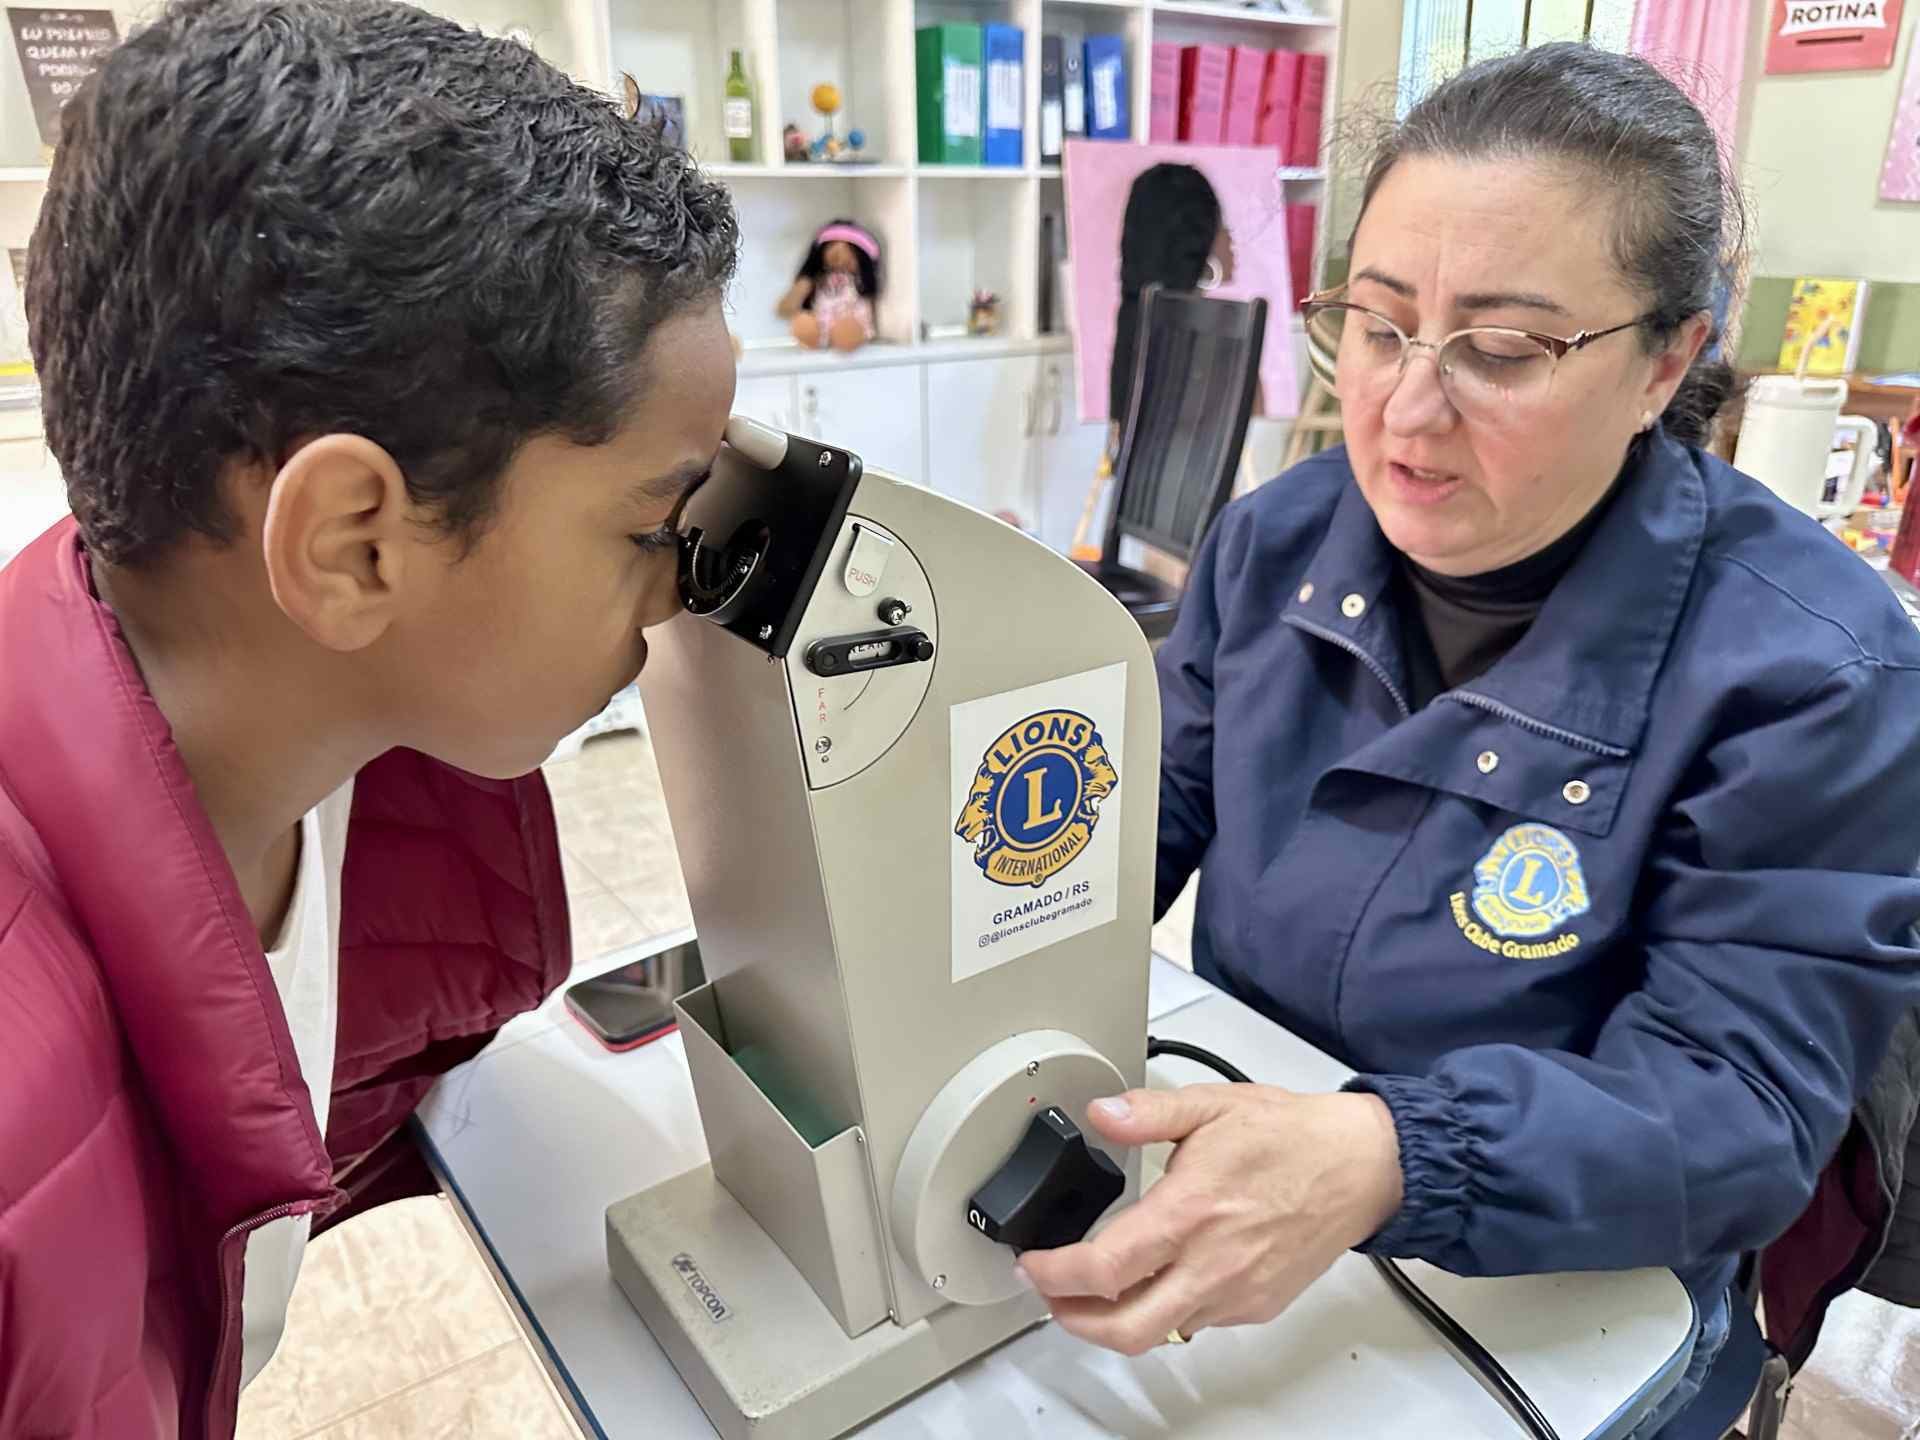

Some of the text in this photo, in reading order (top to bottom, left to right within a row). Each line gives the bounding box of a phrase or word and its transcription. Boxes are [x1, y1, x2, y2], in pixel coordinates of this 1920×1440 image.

[1791, 2, 1877, 24] ROTINA
[848, 567, 877, 587] PUSH
[817, 688, 827, 722] FAR
[993, 716, 1087, 768] LIONS
[1023, 767, 1062, 830] L
[993, 831, 1083, 877] INTERNATIONAL
[1509, 858, 1543, 906] L
[993, 891, 1063, 925] GRAMADO
[1072, 881, 1090, 896] RS
[1501, 932, 1581, 960] Gramado
[1048, 1109, 1065, 1125] 1
[969, 1208, 987, 1232] 2
